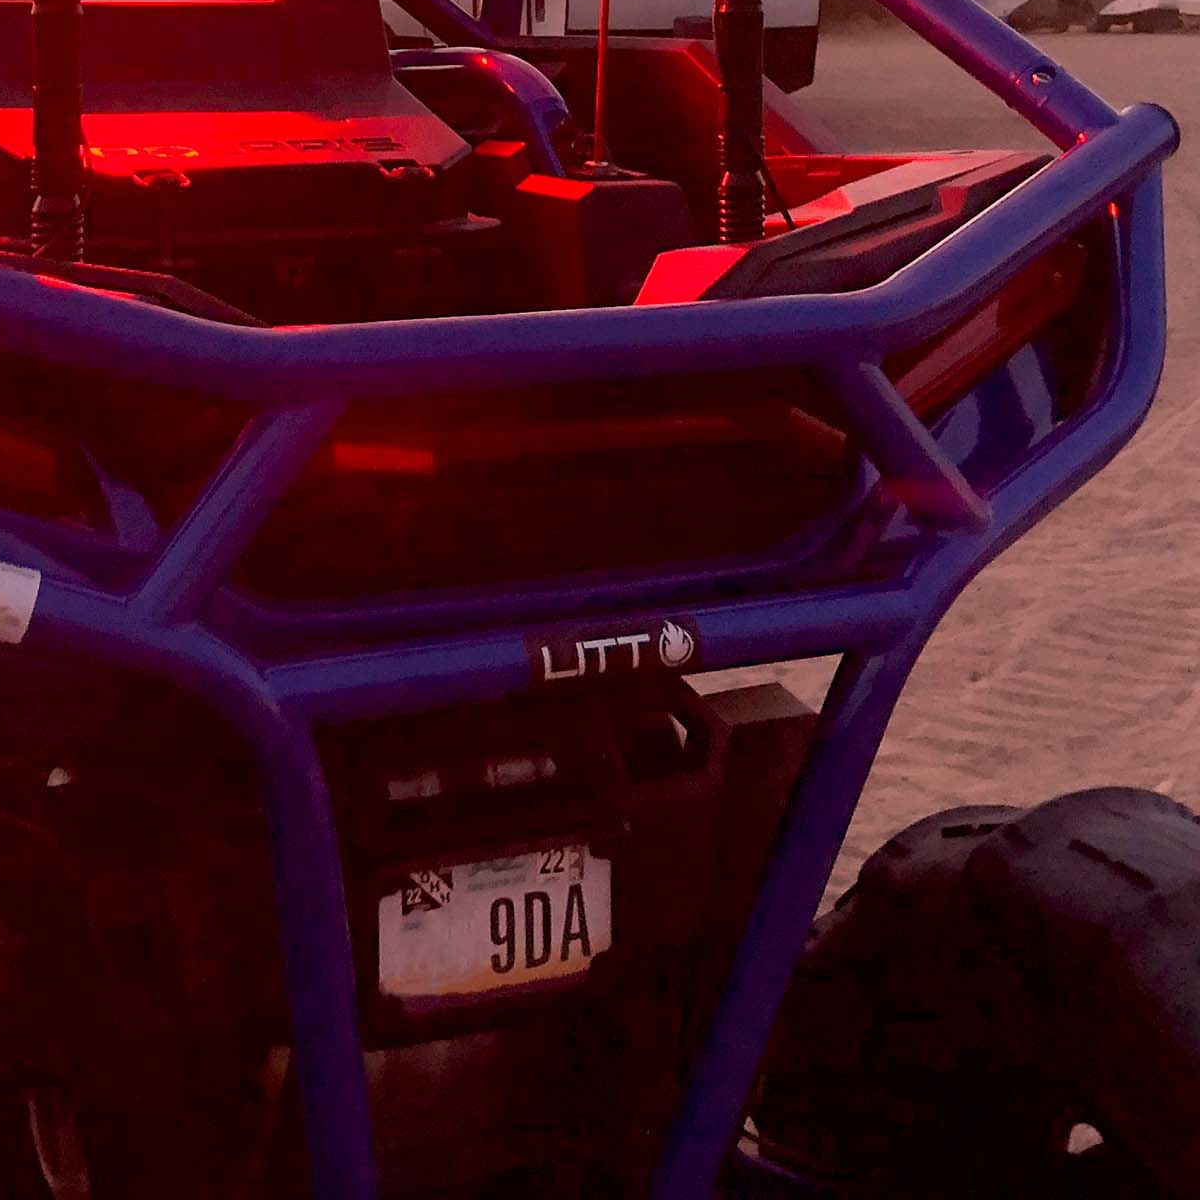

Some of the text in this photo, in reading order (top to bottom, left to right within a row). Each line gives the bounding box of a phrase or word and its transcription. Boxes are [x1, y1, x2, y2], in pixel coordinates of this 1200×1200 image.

[541, 633, 650, 681] LITT
[406, 887, 422, 905] 22
[489, 882, 591, 974] 9DA
